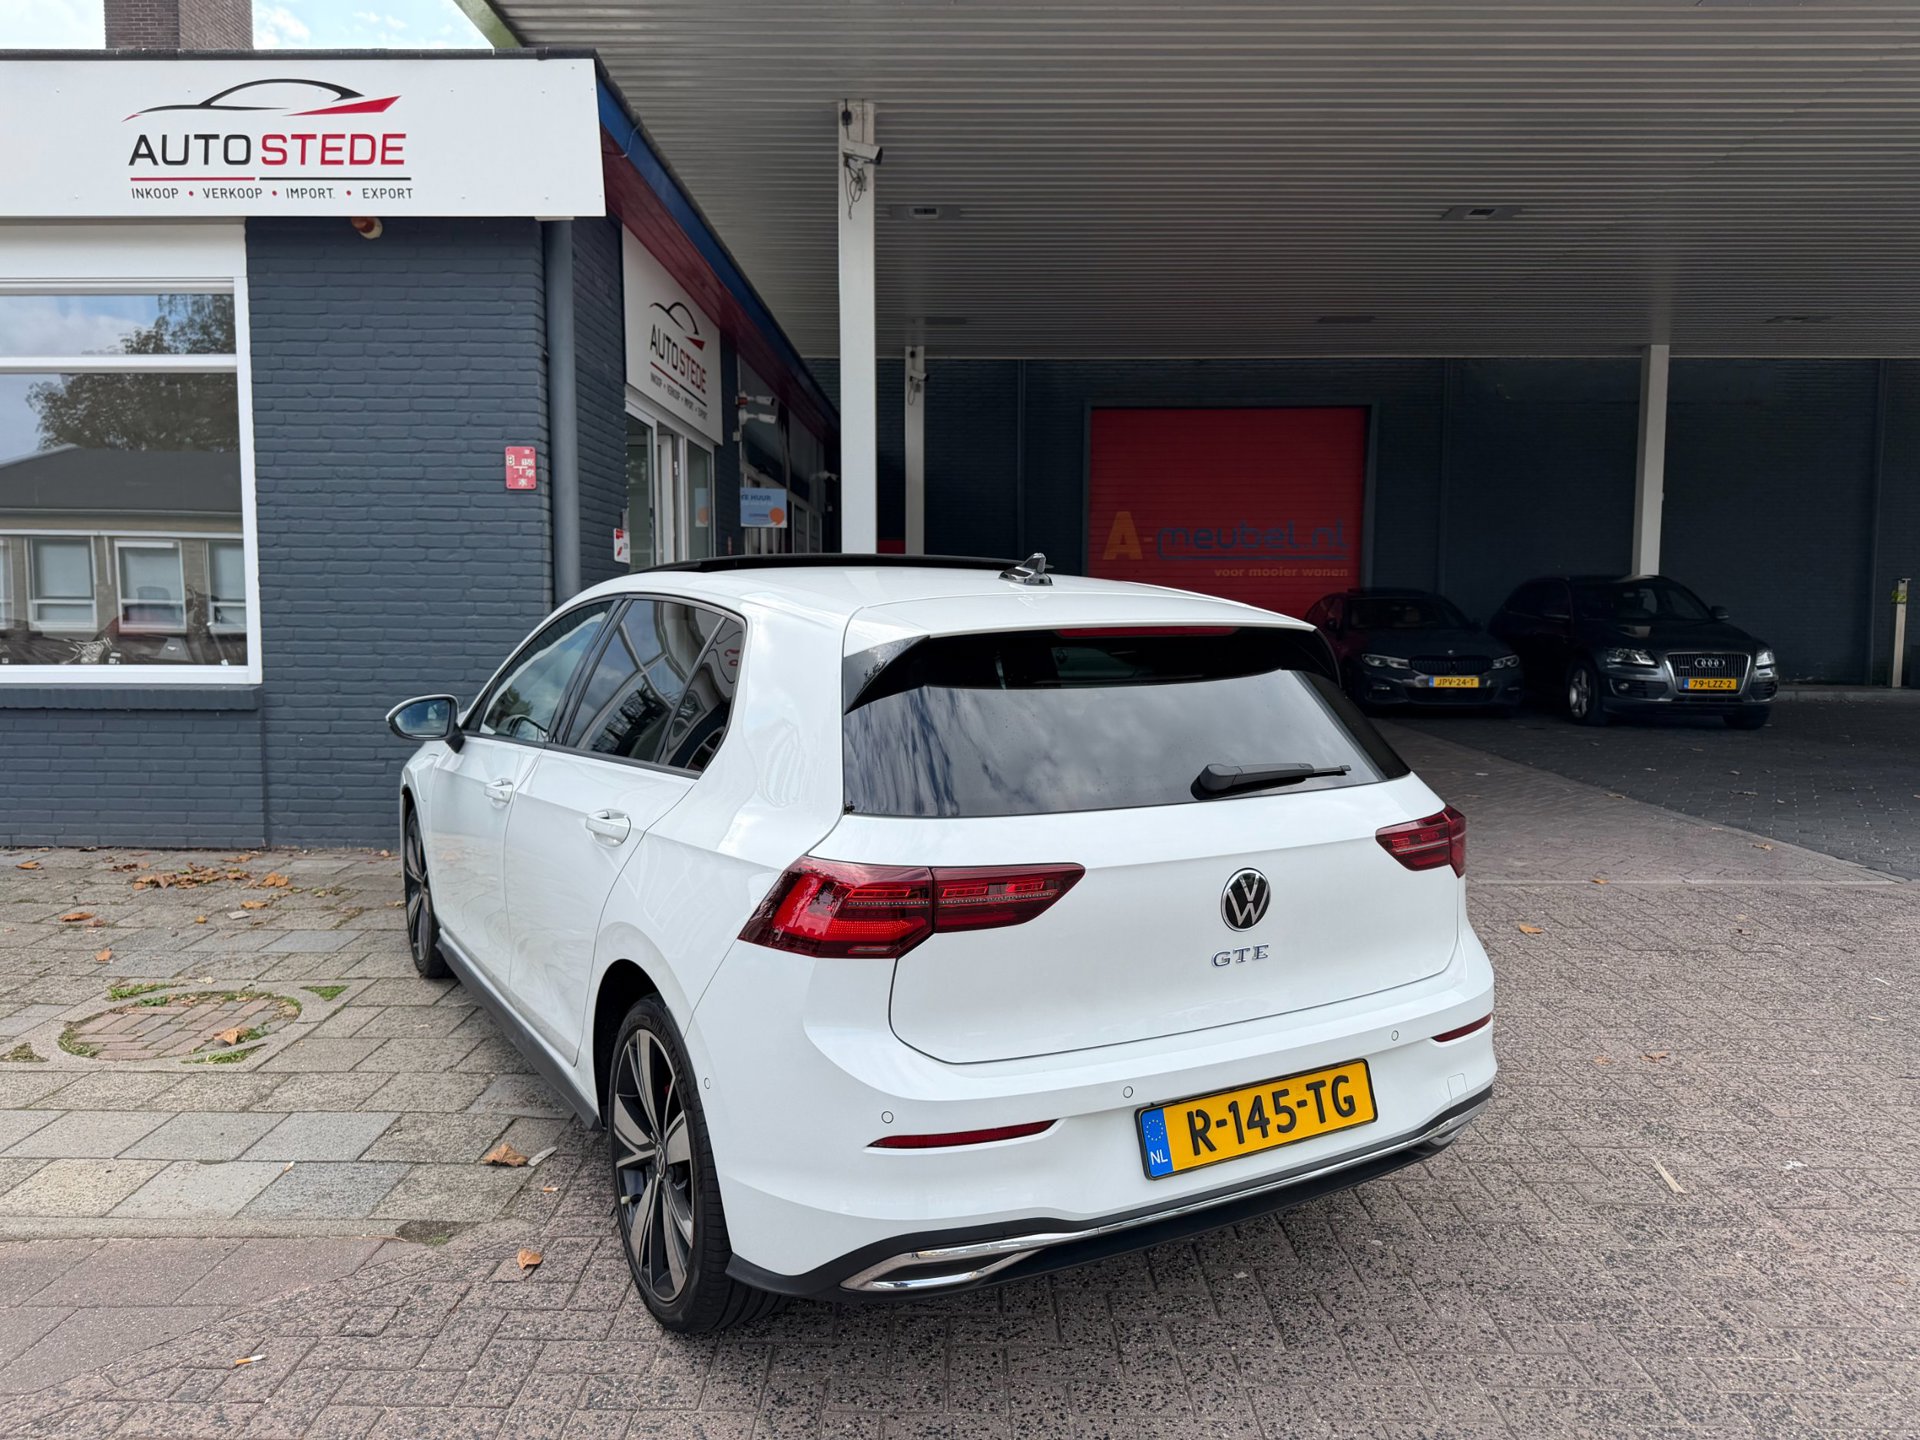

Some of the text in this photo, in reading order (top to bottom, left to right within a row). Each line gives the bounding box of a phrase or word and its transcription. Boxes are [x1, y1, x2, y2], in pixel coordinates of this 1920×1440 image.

[131, 187, 179, 199] INKOOP
[202, 187, 263, 199] VERKOOP
[362, 187, 413, 199] EXPORT
[1214, 565, 1348, 577] voor mooier wonen
[1438, 678, 1475, 686] JPV-24-T
[1693, 680, 1732, 688] 79-LZZ-2
[1211, 944, 1269, 967] GTE
[1187, 1075, 1357, 1156] R-145-TG
[1150, 1148, 1169, 1166] NL
